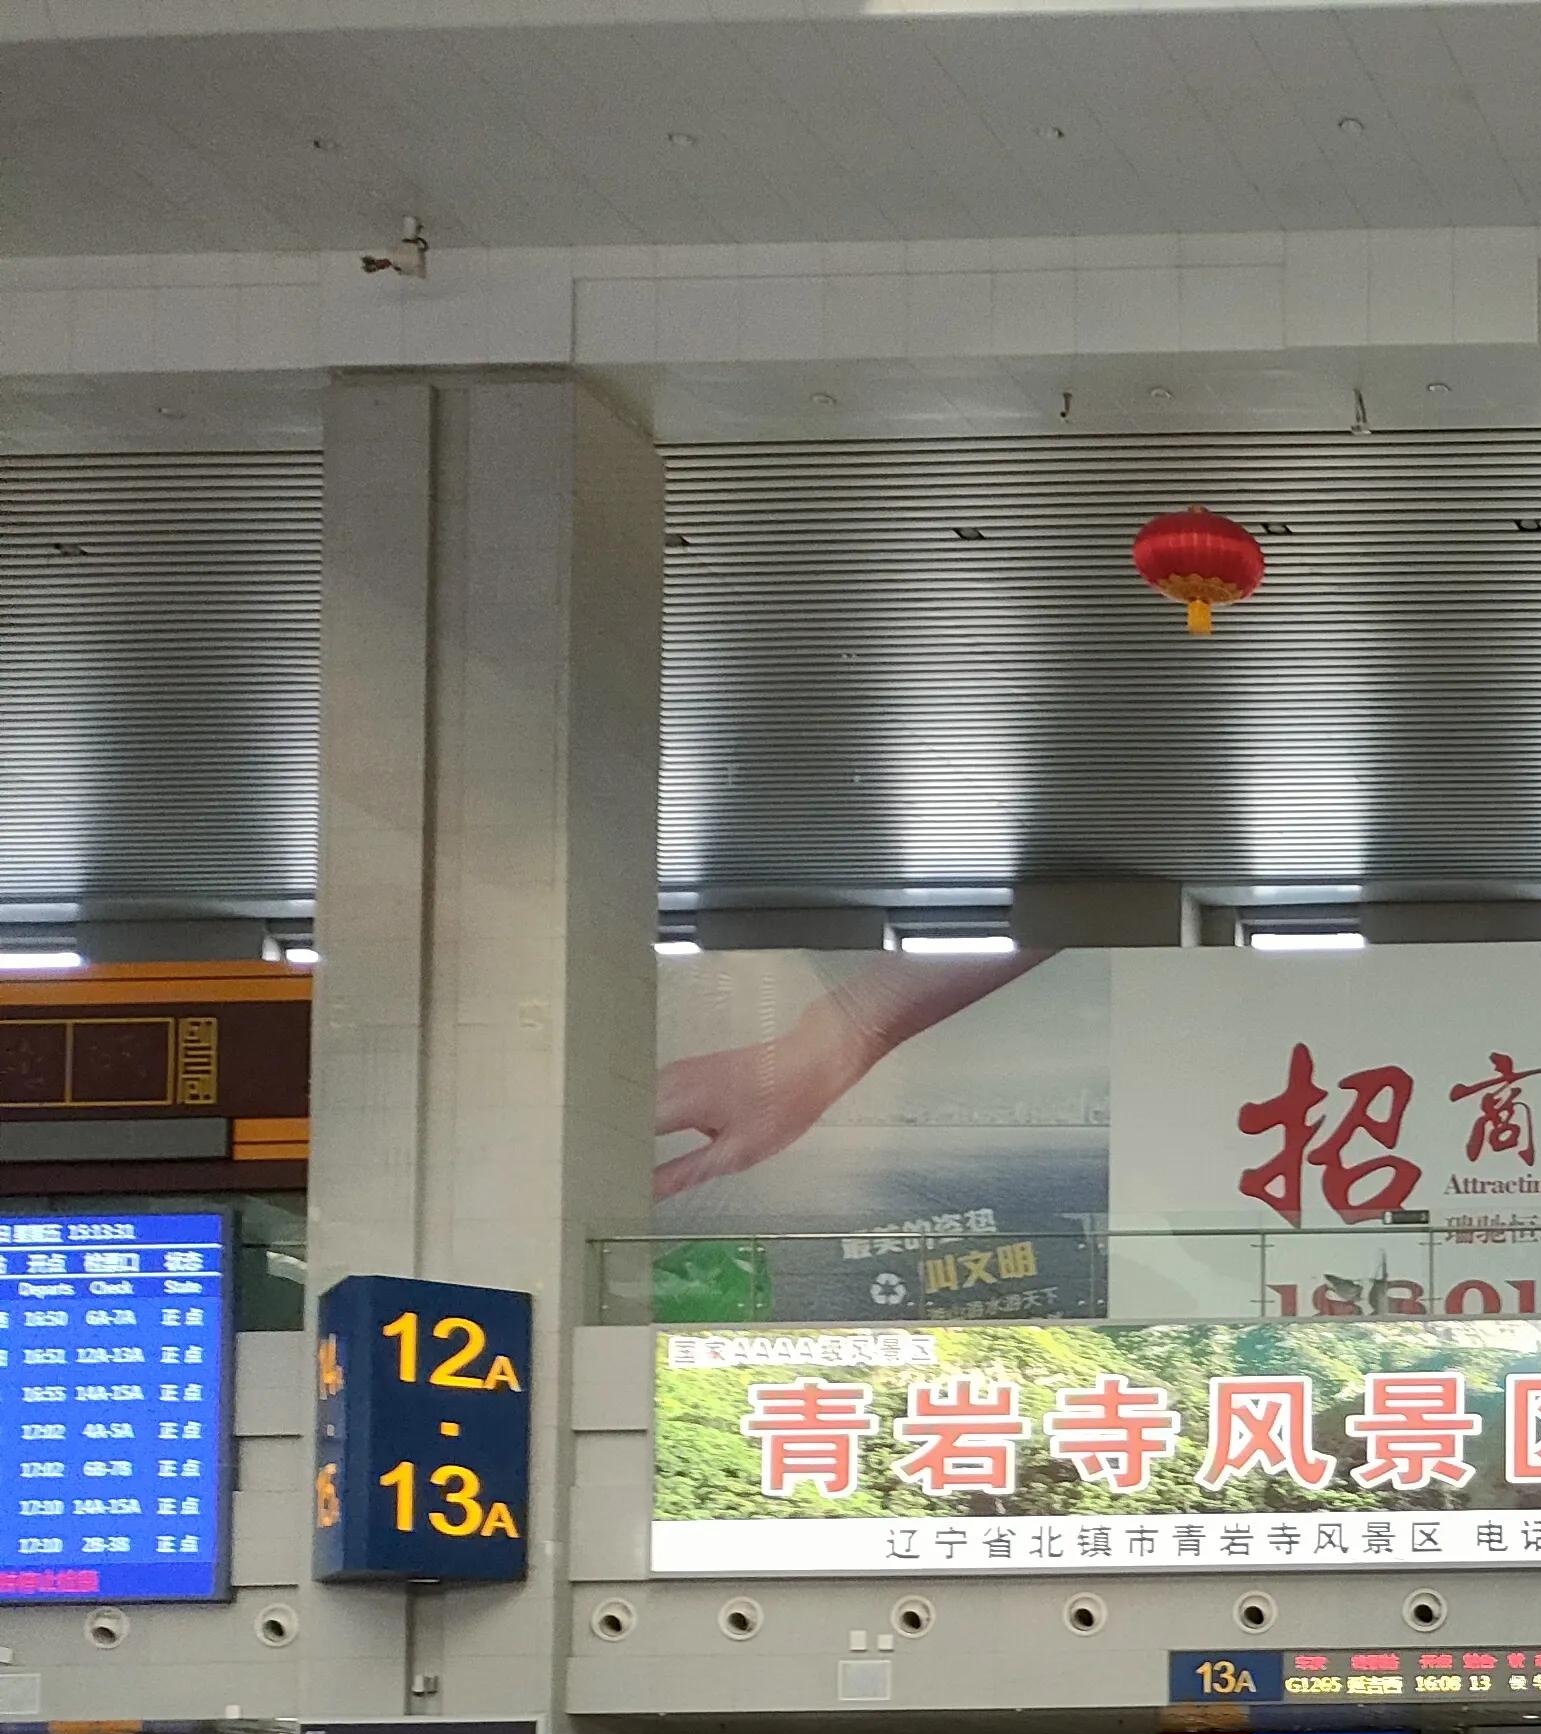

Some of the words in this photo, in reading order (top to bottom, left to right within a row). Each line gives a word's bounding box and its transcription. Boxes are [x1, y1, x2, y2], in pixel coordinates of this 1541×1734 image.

[382, 1311, 521, 1393] 12A
[380, 1460, 520, 1540] 13A
[885, 1522, 1443, 1561] 辽宁省北镇市青岩寺风景区
[1195, 1661, 1257, 1694] 13A
